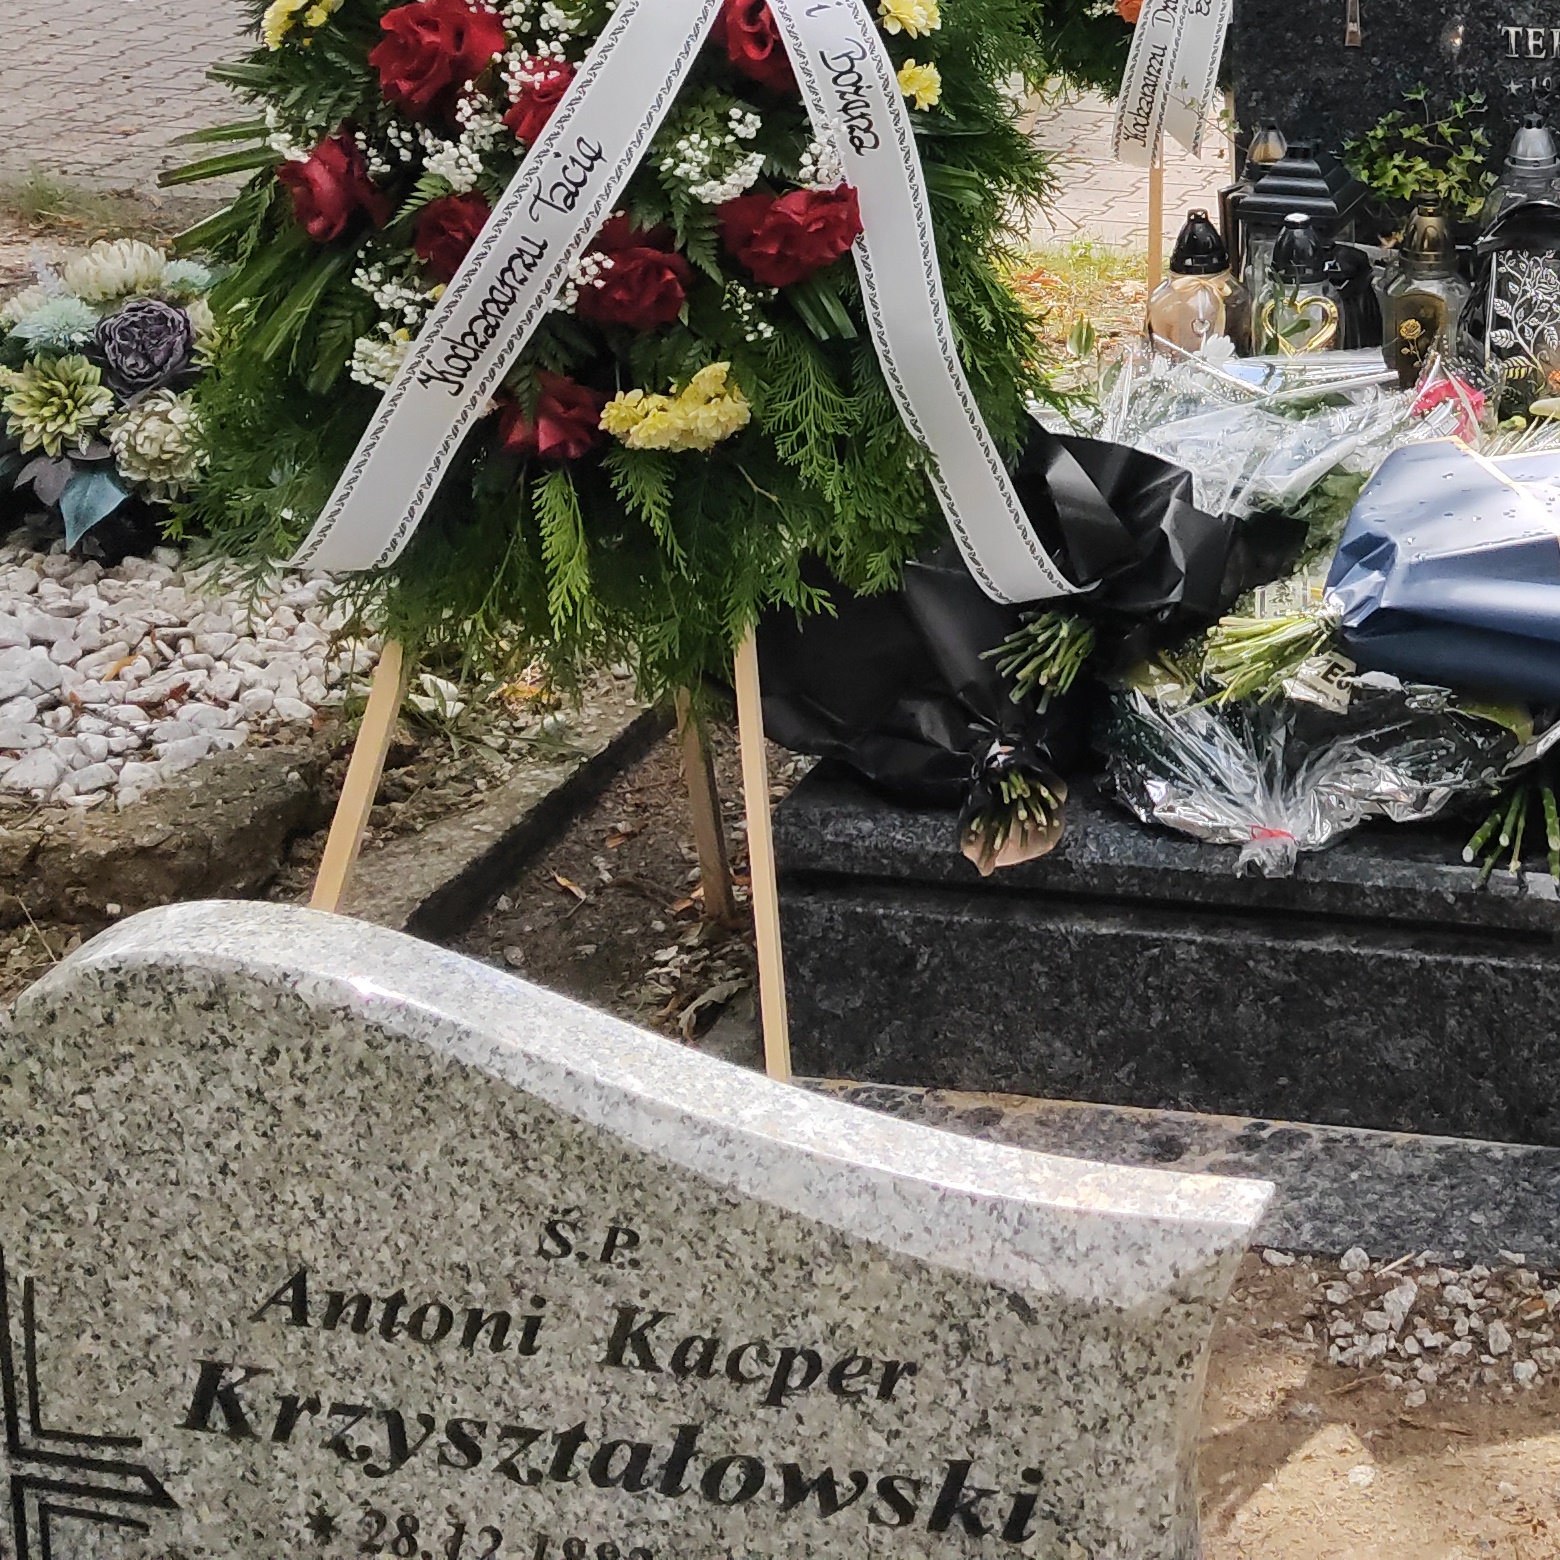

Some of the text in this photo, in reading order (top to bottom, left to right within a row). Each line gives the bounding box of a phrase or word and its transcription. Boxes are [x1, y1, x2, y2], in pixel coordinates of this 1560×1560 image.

[804, 1, 843, 18] i
[818, 37, 880, 157] Bożena
[247, 1262, 918, 1406] Antoni Kacper
[175, 1358, 1049, 1544] Krzyształowski
